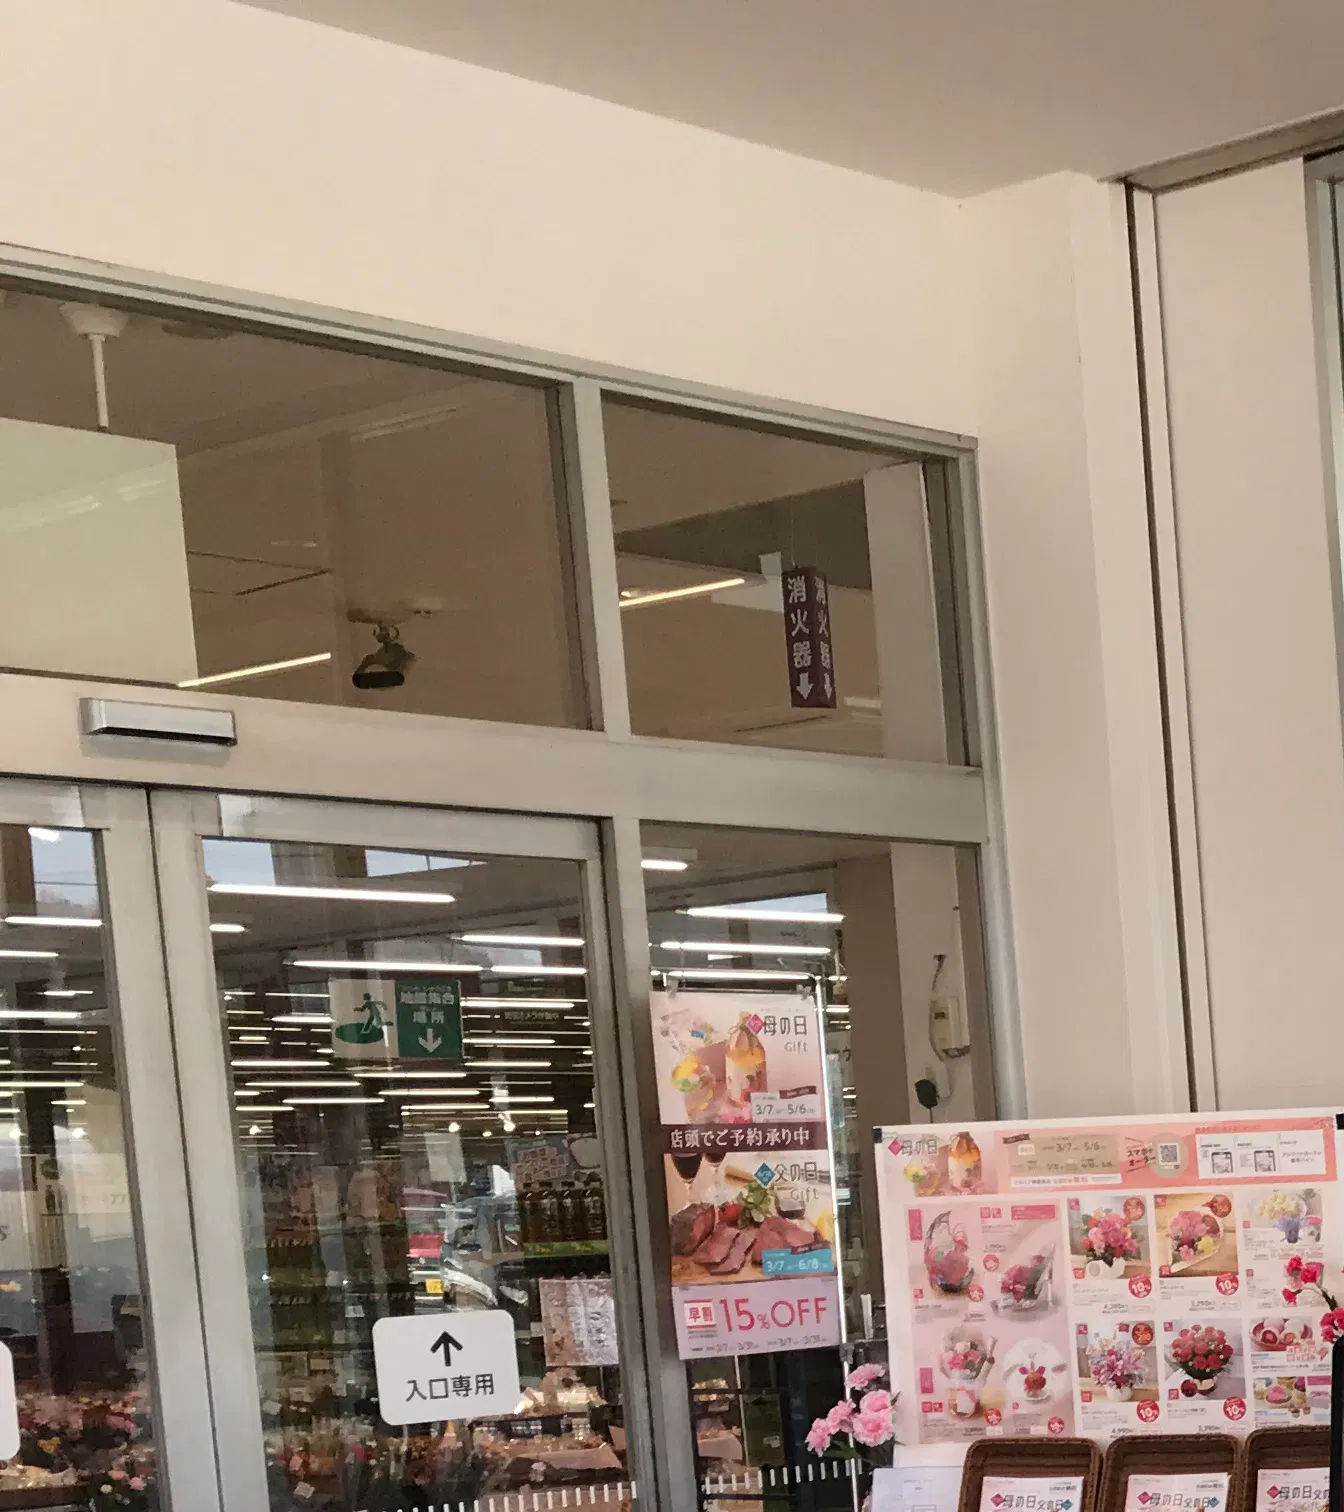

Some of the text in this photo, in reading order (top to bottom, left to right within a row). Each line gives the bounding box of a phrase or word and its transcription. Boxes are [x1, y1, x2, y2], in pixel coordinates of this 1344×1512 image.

[787, 576, 811, 668] 消火器
[814, 576, 830, 669] 消火器
[764, 1015, 808, 1036] 母の日
[784, 1041, 808, 1054] Gift
[671, 1127, 810, 1148] 店頭でご予約承り中
[901, 1139, 937, 1156] 母の日
[775, 1162, 818, 1182] 父の日
[406, 1374, 495, 1402] 入口専用
[1002, 1494, 1035, 1509] 母の日
[1149, 1492, 1183, 1506] 母の日
[1279, 1485, 1312, 1500] 母の日
